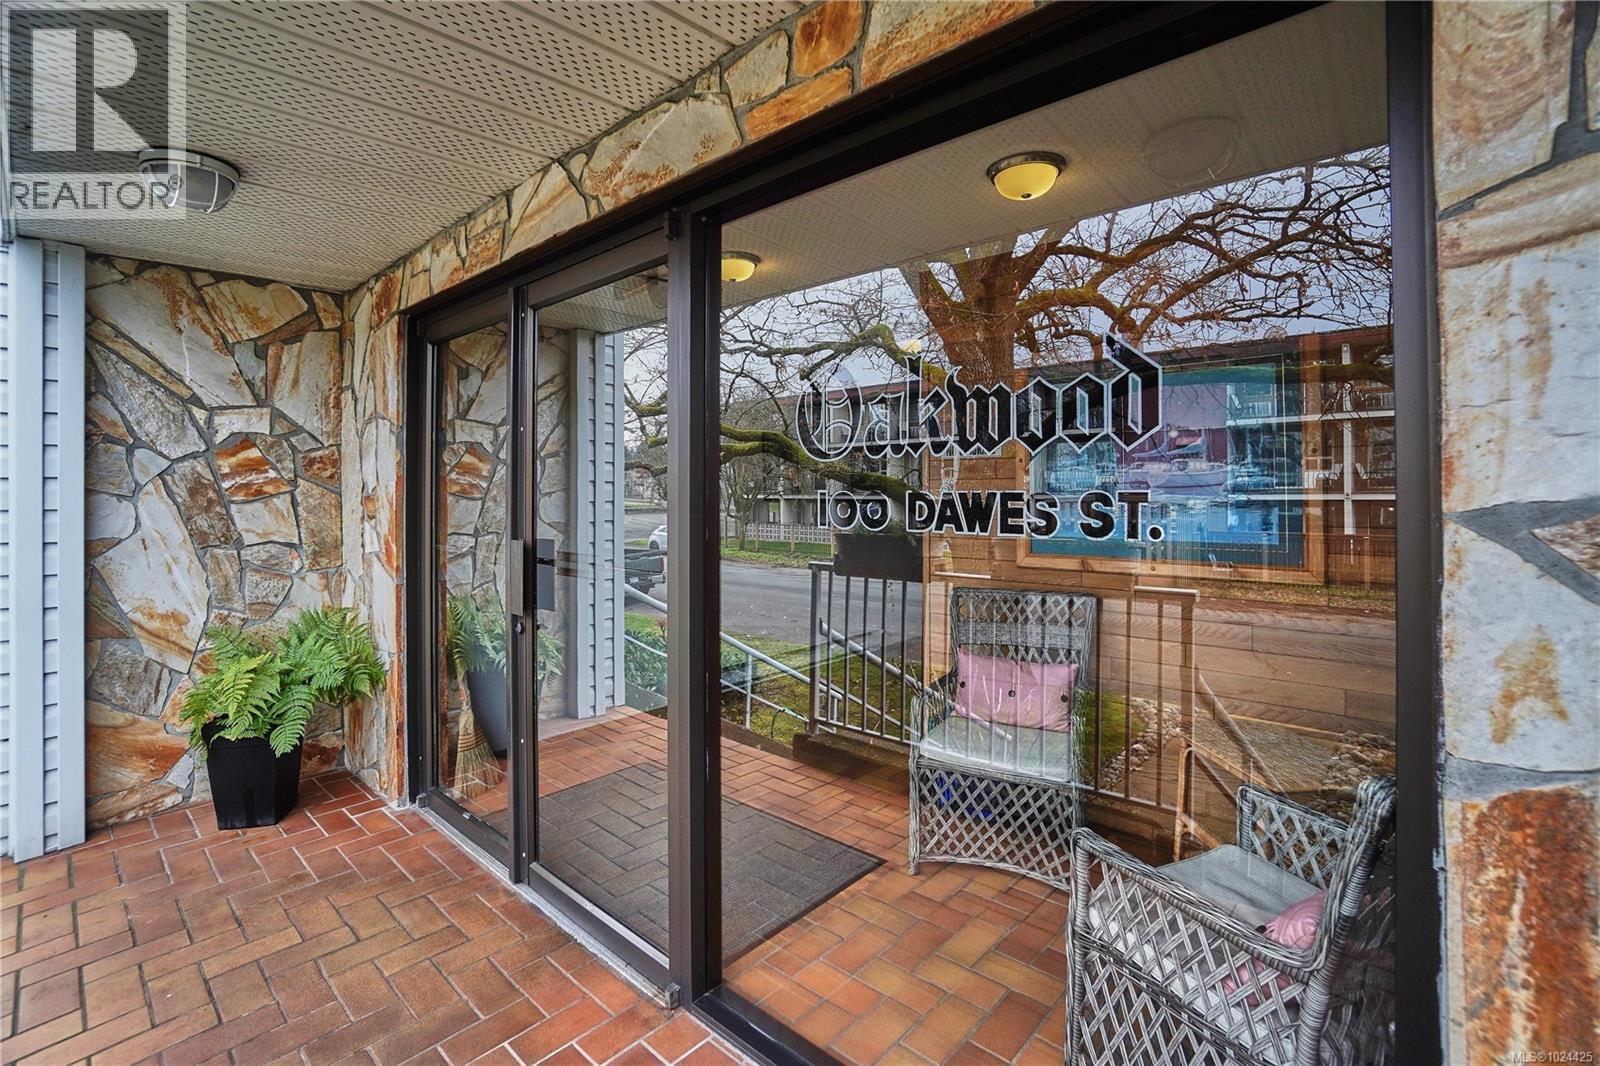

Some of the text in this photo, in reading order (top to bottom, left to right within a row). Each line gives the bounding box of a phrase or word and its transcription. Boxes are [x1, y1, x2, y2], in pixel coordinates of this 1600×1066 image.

[795, 331, 1164, 462] Oakwood
[816, 489, 1166, 543] 100 DAWES ST.
